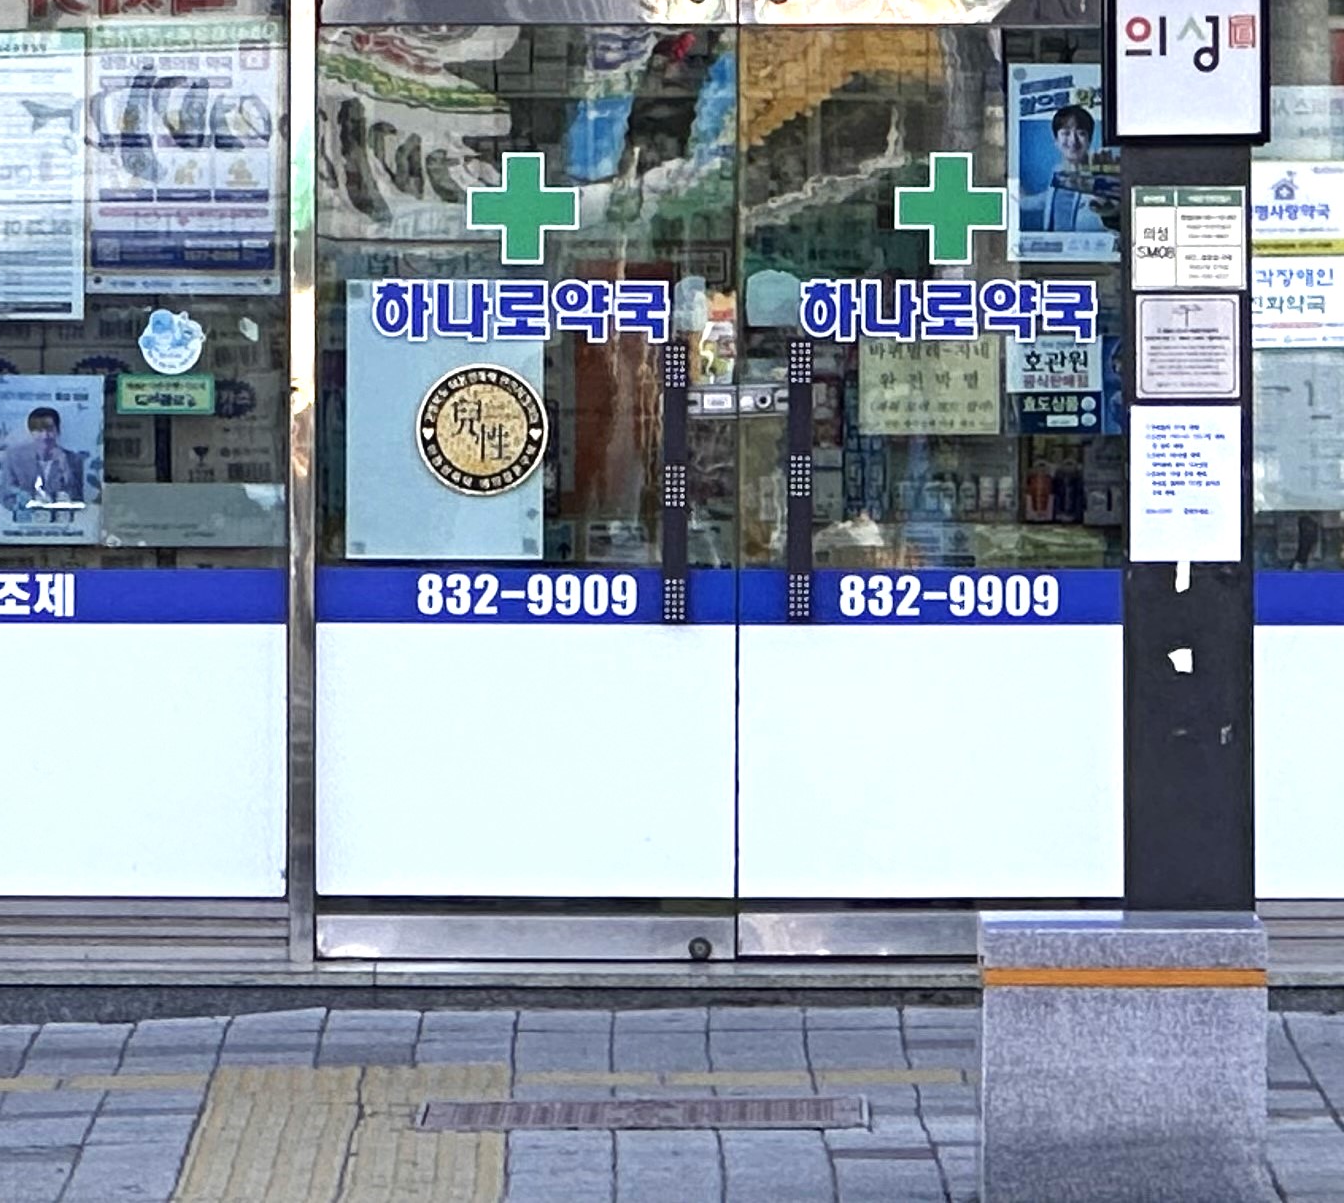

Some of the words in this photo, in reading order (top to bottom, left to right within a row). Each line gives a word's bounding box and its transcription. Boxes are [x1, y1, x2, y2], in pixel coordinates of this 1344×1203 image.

[1252, 203, 1330, 221] 명사랑약국
[1256, 268, 1335, 287] 각장애인
[372, 279, 671, 343] 하나로약국
[799, 279, 1099, 343] 하나로약국
[1021, 349, 1089, 374] 호관원
[417, 573, 638, 616] 832-9909
[839, 574, 1060, 617] 832-9909
